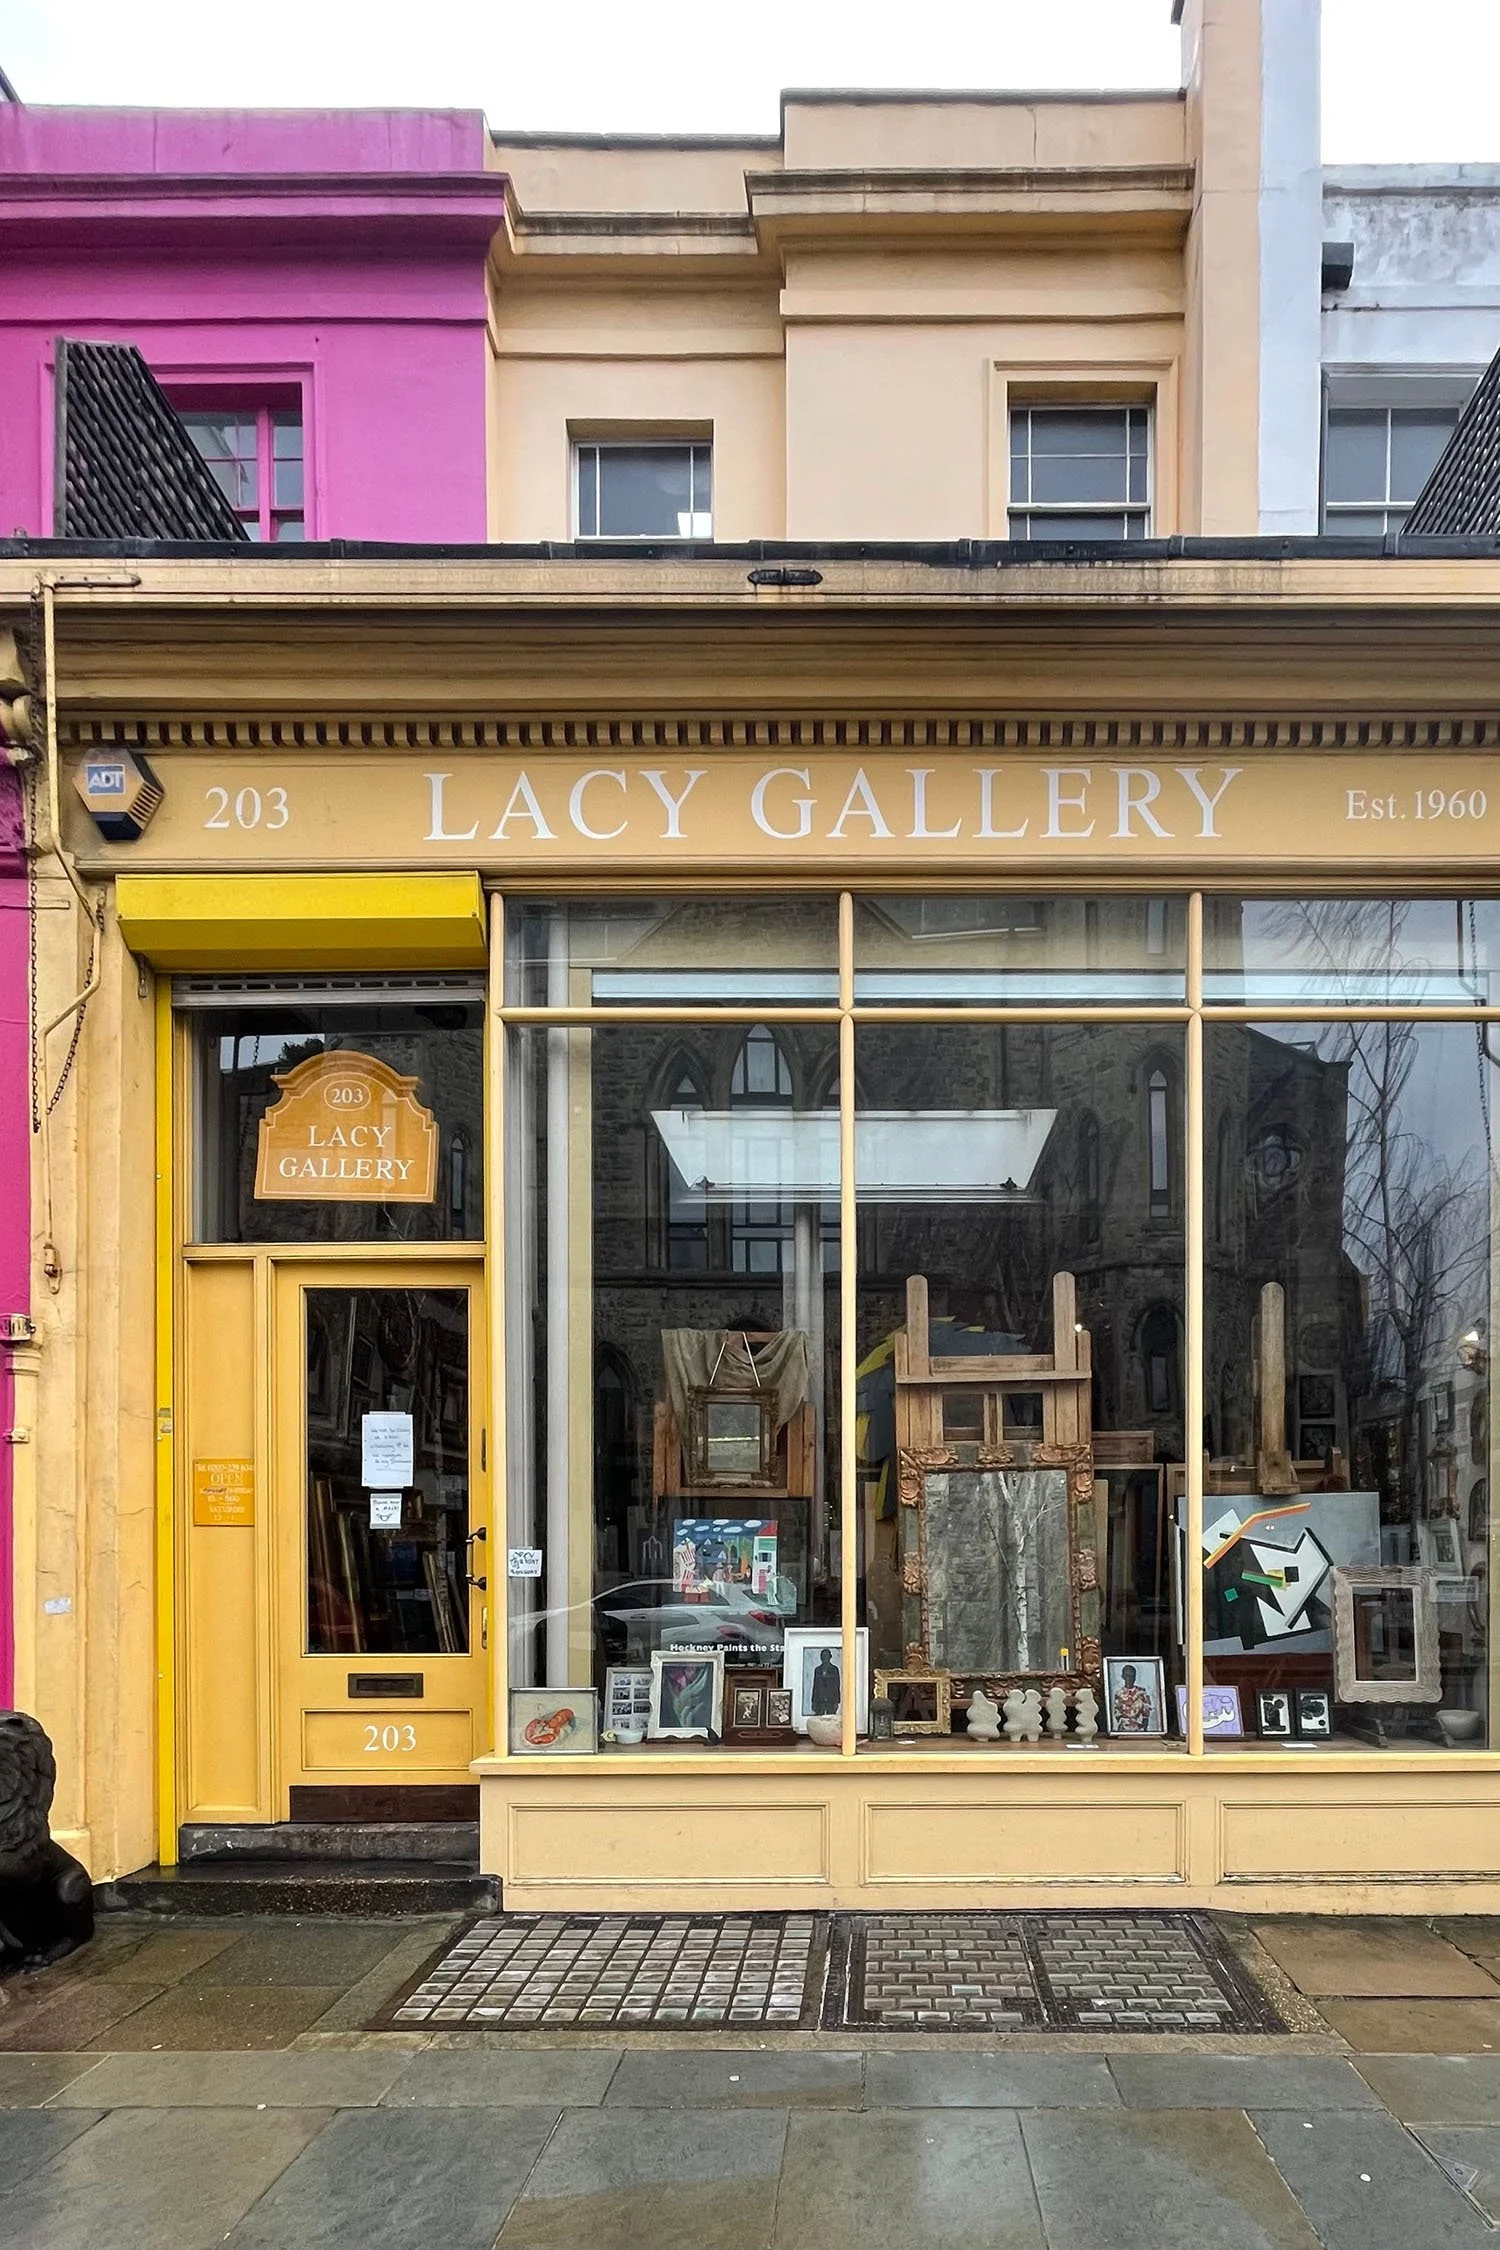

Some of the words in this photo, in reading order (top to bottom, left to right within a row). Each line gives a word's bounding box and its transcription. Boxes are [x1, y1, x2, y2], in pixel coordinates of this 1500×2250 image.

[88, 771, 125, 789] ADT
[204, 787, 290, 830] 203
[423, 770, 707, 842] LACY
[750, 767, 1243, 841] GALLERY
[1345, 790, 1406, 820] Est.
[1415, 789, 1488, 820] 1960
[332, 1087, 363, 1104] 203
[308, 1125, 392, 1148] LACY
[279, 1156, 414, 1180] GALLERY
[669, 1643, 714, 1653] Hockney
[716, 1643, 749, 1653] Paints
[750, 1643, 768, 1653] the
[364, 1724, 417, 1751] 203
